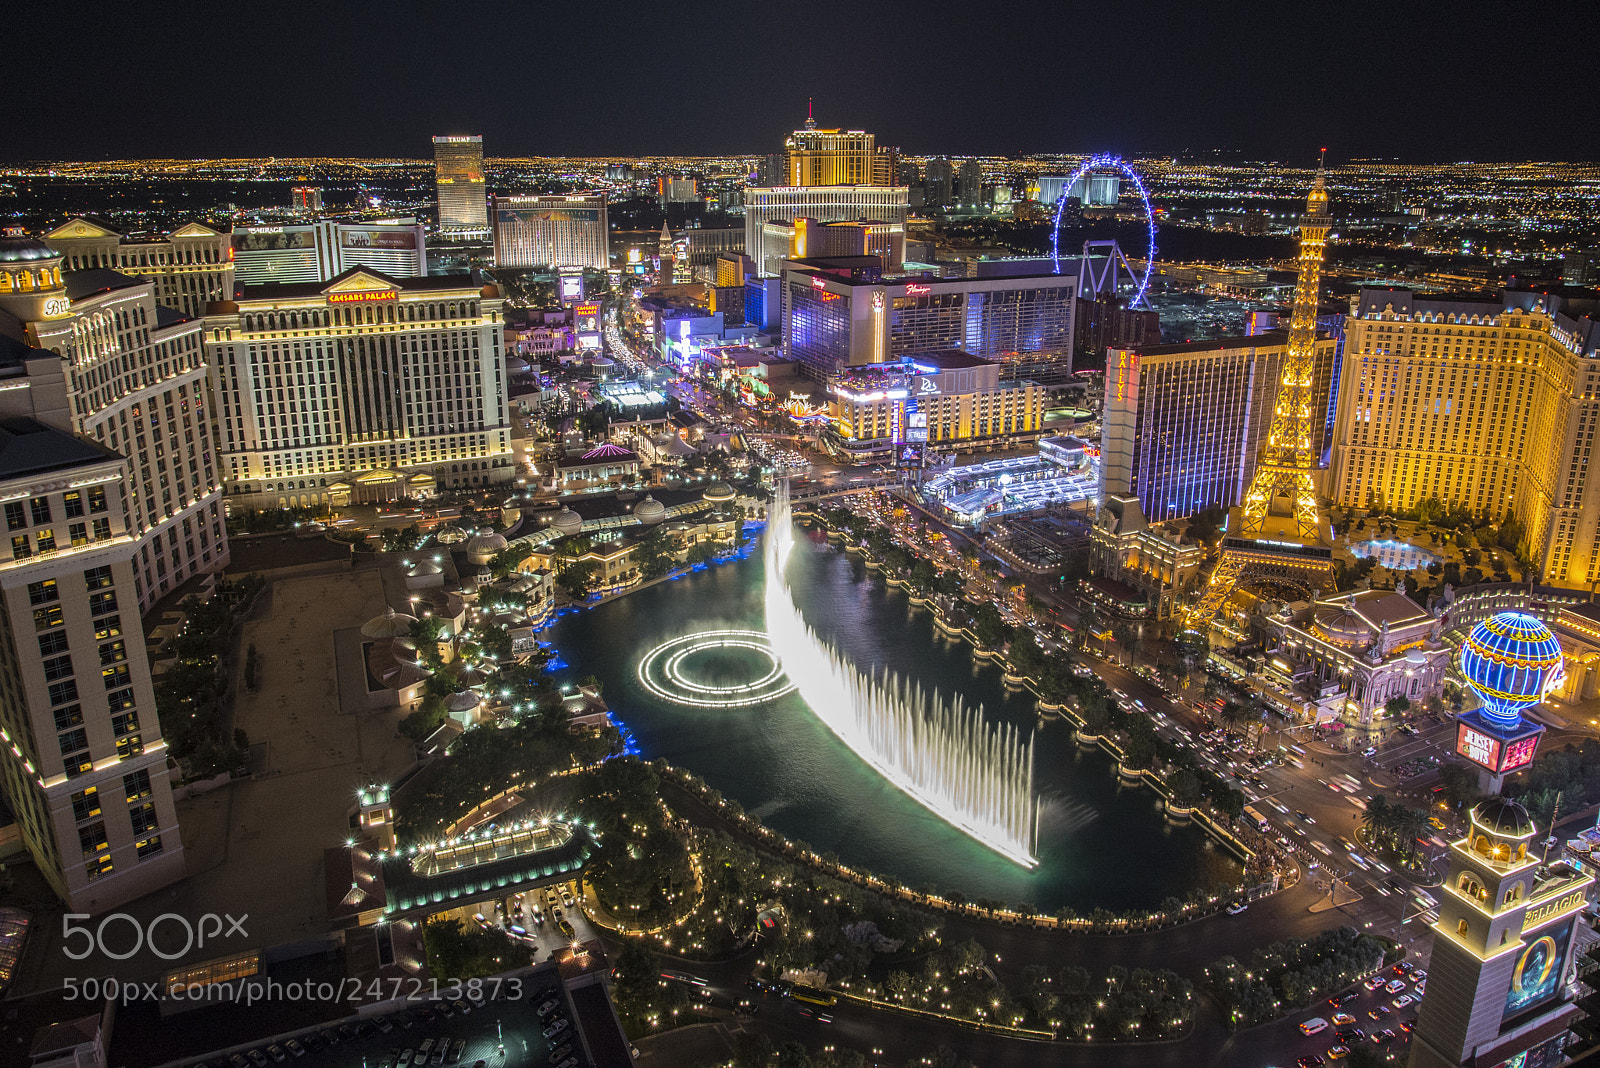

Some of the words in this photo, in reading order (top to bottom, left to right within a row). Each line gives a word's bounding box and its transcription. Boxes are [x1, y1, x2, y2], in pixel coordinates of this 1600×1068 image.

[329, 294, 363, 303] CAESARS
[365, 291, 396, 300] PALACE
[1464, 729, 1495, 753] JERSEY
[1469, 744, 1490, 765] BOYS
